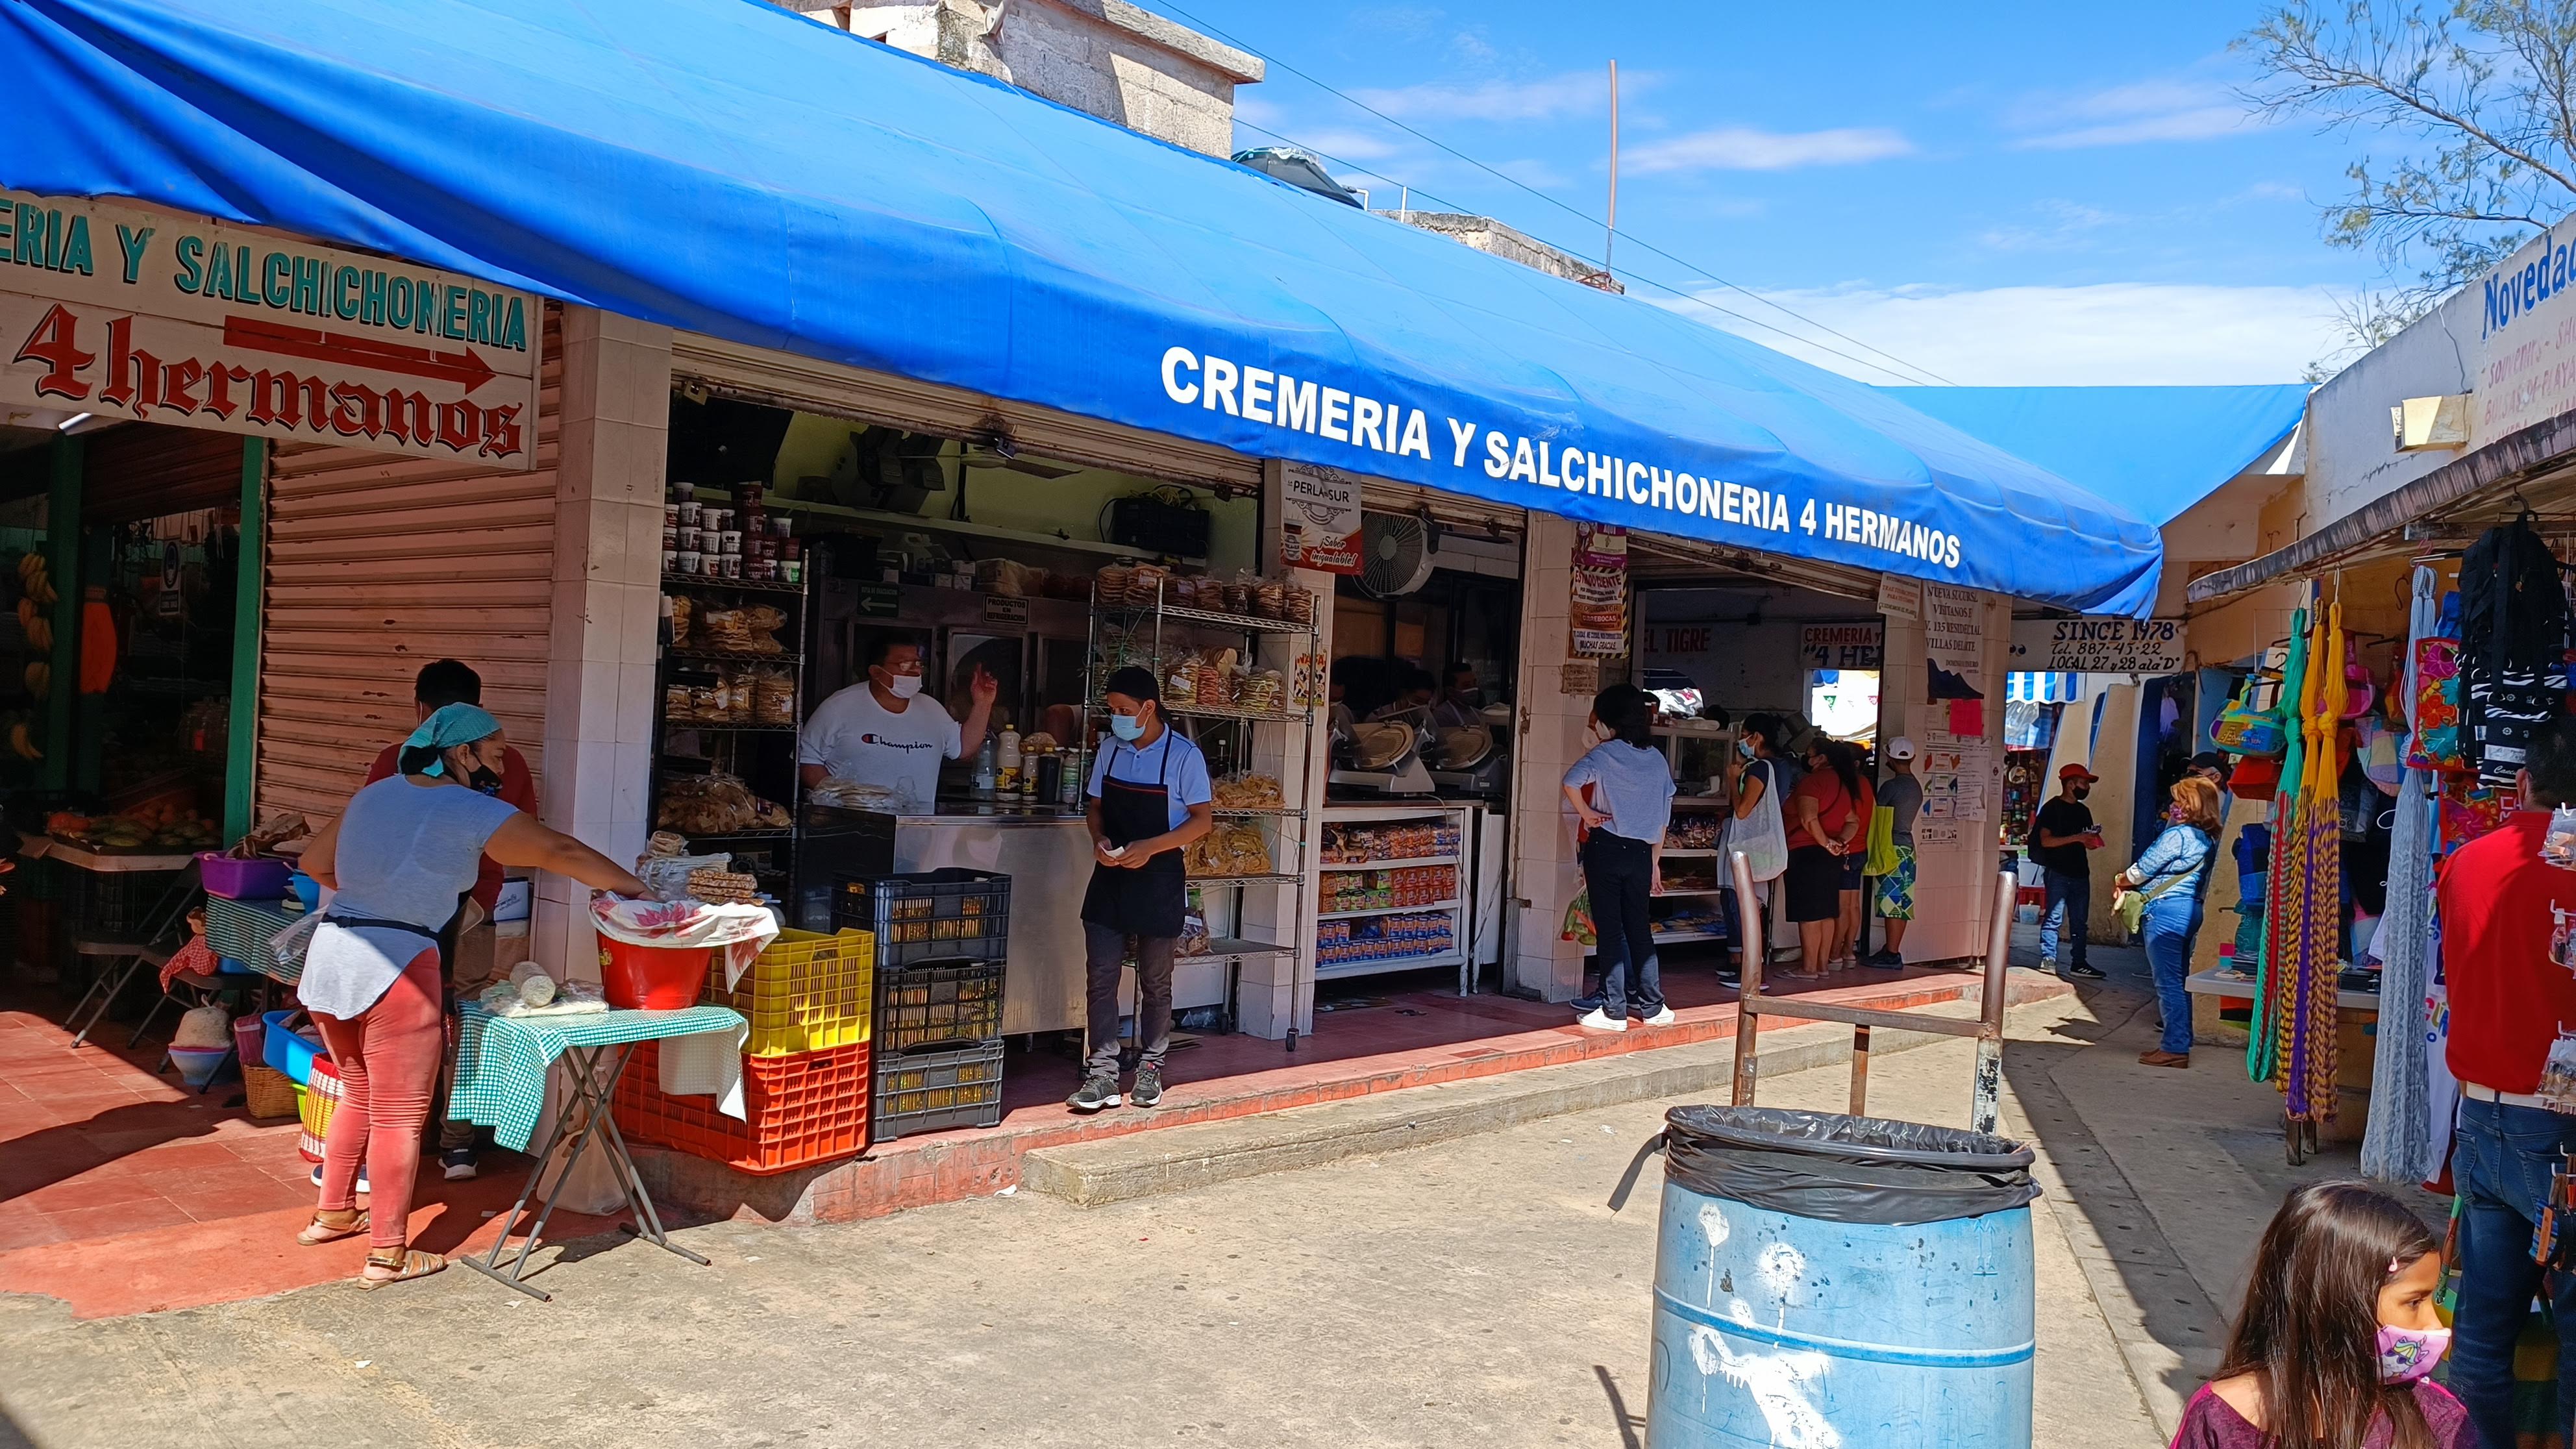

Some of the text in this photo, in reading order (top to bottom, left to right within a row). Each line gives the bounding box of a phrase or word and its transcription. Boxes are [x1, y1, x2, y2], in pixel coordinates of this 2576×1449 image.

[117, 223, 155, 284] Y
[175, 235, 526, 352] SALCHICHONERIA
[14, 304, 523, 459] 4 hermanos
[1161, 347, 1961, 569] CREMERIA Y SALCHICHONERIA 4 HERMANOS
[1293, 480, 1325, 498] PERLA
[1329, 489, 1350, 502] SUR
[1319, 536, 1345, 549] ¡Sabor
[1311, 551, 1357, 566] inigualable!
[1927, 586, 1951, 599] NUEVA
[988, 599, 1025, 608] PRODUCTOS
[1934, 622, 1946, 632] 135
[2053, 621, 2174, 640] SINCE 1978
[1666, 628, 1711, 652] TIGRE
[1805, 628, 1872, 643] CREMERIA
[1926, 638, 1952, 650] VILLAS
[2050, 641, 2071, 655] Tel.
[2047, 656, 2087, 670] LOCAL
[2091, 656, 2109, 670] 27
[861, 734, 933, 754] Champion
